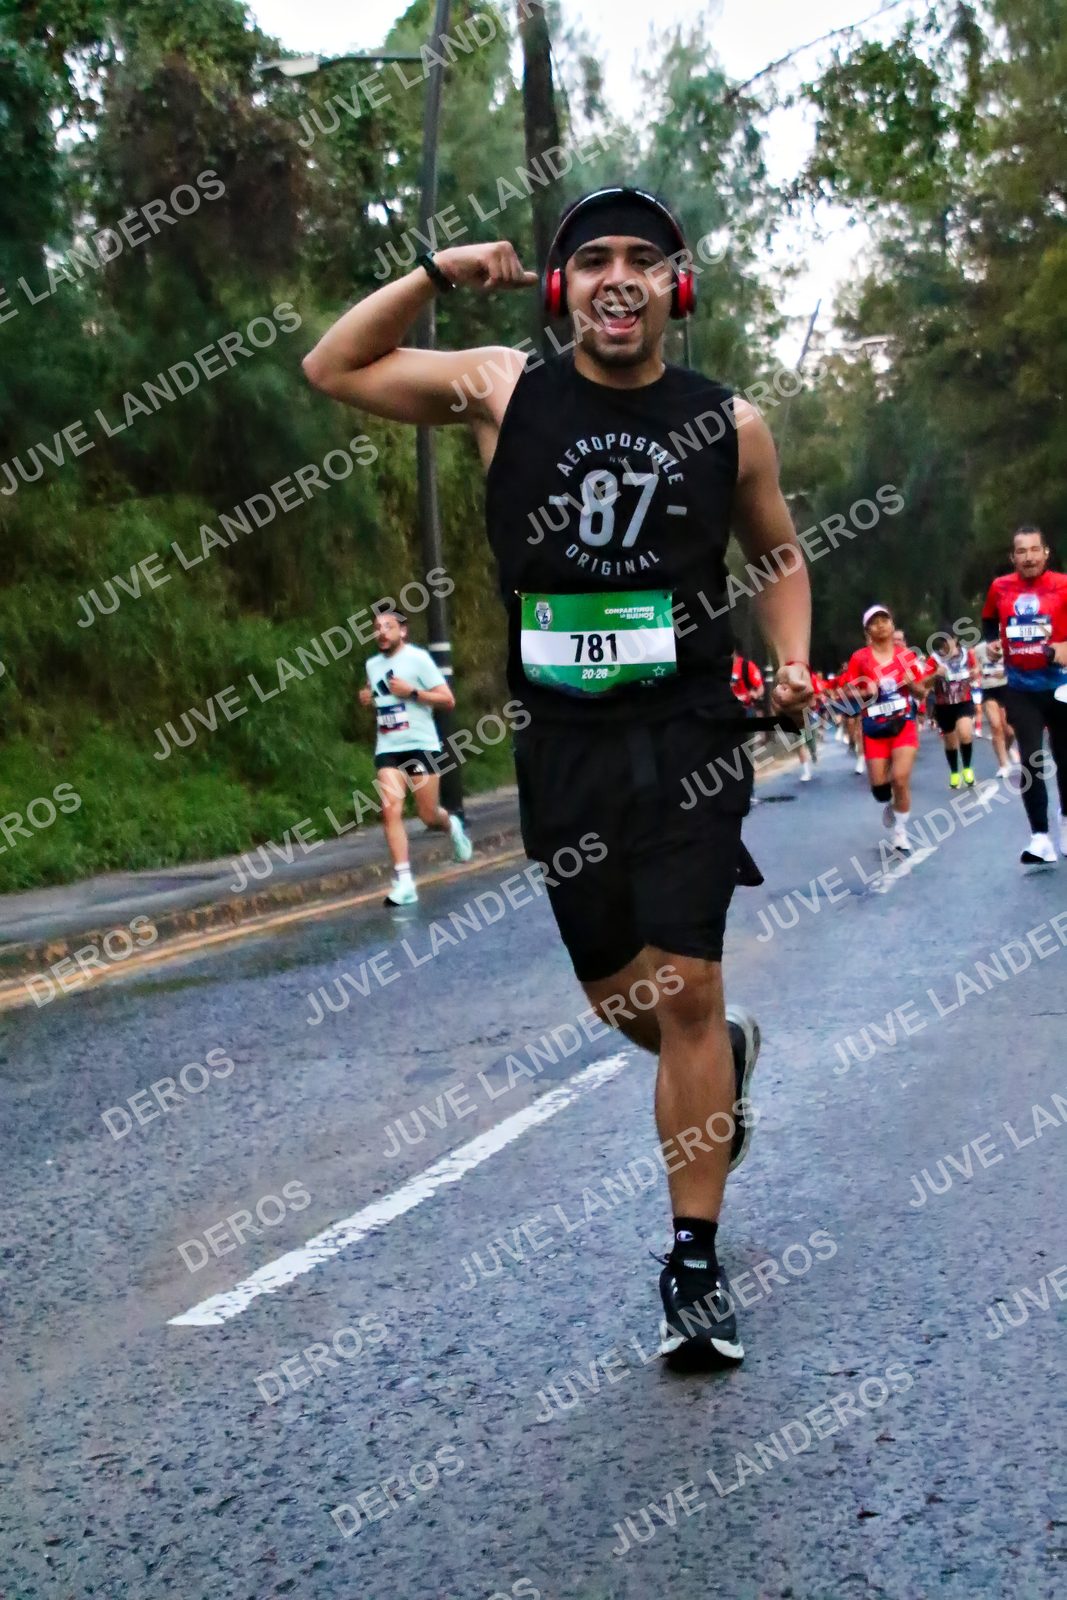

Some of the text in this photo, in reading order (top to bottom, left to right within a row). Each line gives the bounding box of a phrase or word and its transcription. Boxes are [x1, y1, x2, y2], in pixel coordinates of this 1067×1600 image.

[557, 432, 684, 485] AEROPOSTALE
[579, 469, 659, 548] 87
[565, 543, 660, 576] ORIGINAL
[570, 633, 618, 663] 781
